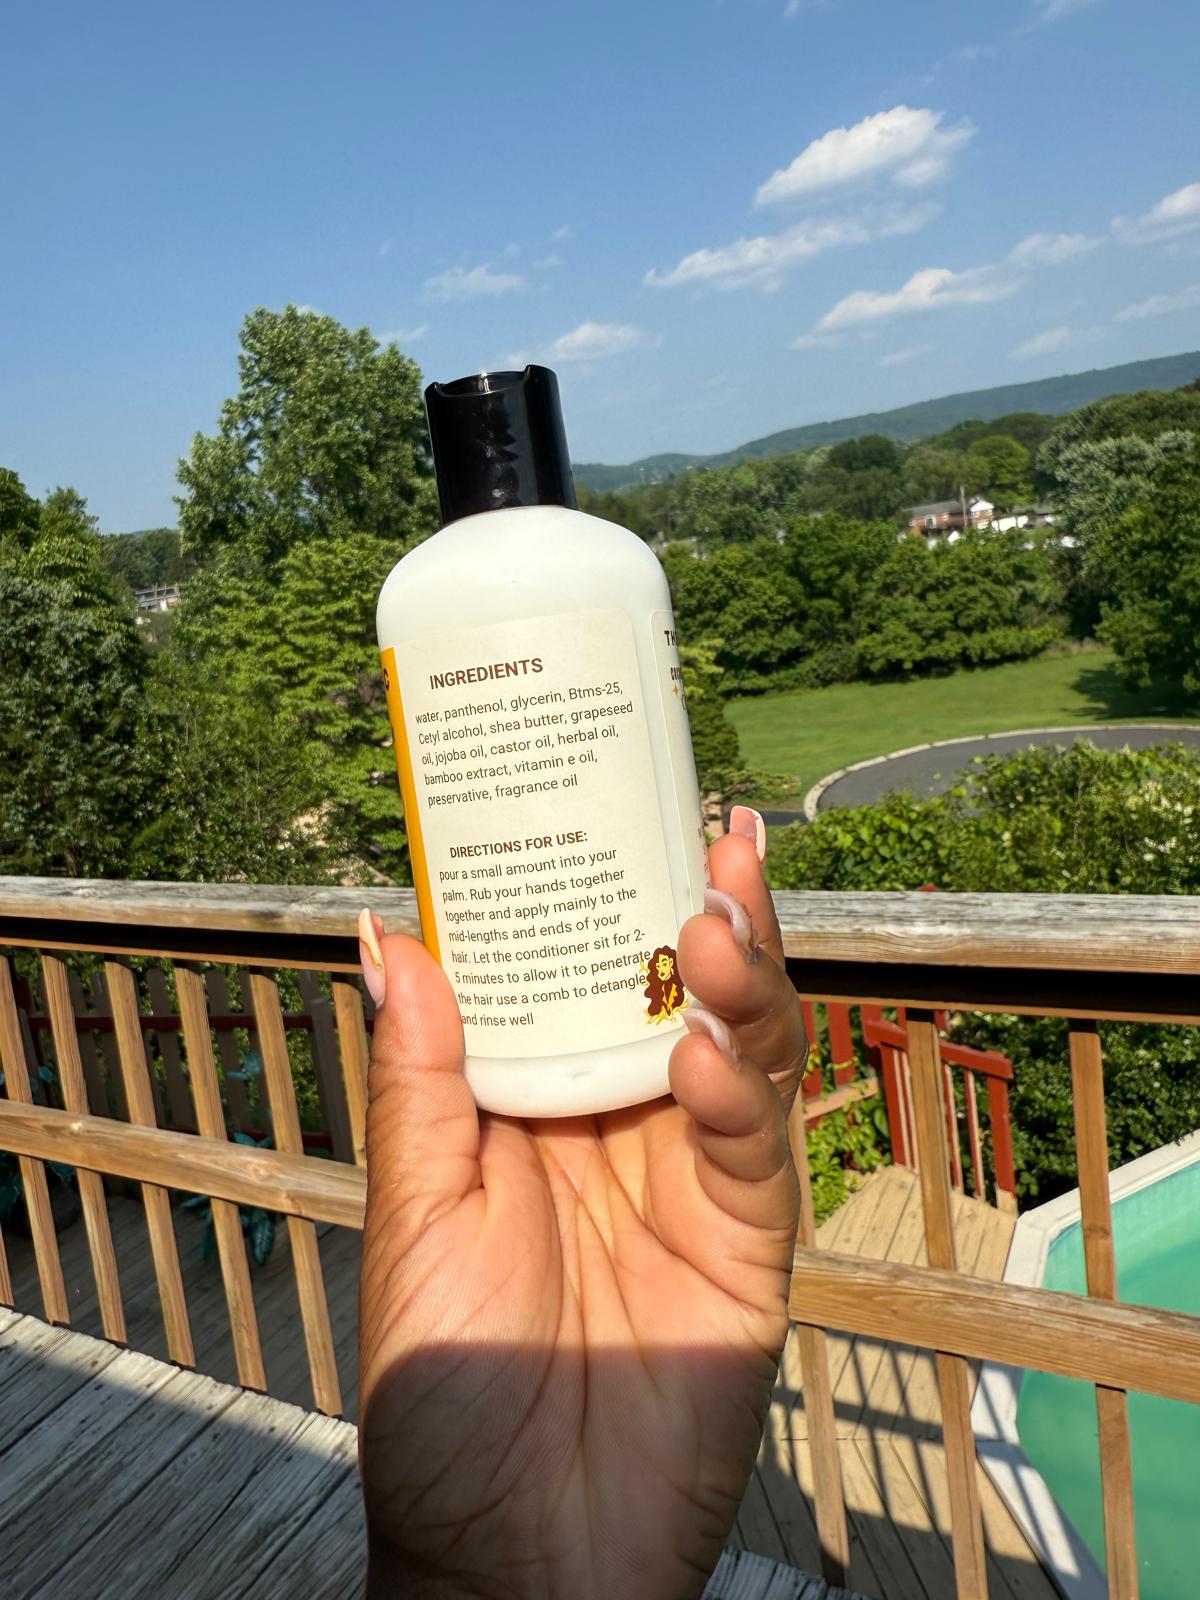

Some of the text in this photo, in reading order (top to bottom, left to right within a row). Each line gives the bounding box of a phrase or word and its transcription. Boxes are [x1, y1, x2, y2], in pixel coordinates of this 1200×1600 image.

[429, 657, 544, 690] INGREDIENTS
[415, 681, 623, 724] water, panthenol, glycerin, Btms-25,
[418, 701, 634, 747] Cetyl alcohol, shea butter, grapeseed
[421, 724, 619, 766] oil, jojoba oil, castor oil, herbal oil,
[424, 749, 598, 786] bamboo extract, vitamin e oil,
[427, 775, 578, 808] preservative, fragrance oil
[450, 830, 587, 859] DIRECTIONS FOR USE:
[439, 848, 617, 883] pour a small amount into your
[442, 868, 625, 904] palm. Rub your hands together
[445, 887, 637, 925] together and apply mainly to the
[448, 912, 622, 945] mid-lengths and ends of your
[451, 928, 646, 964] hair. Let the conditioner sit for 2-
[455, 949, 651, 985] 5 minutes to allow it to penetrate
[458, 973, 647, 1006] the hair use a comb to detangle
[461, 1012, 534, 1026] and rinse well
